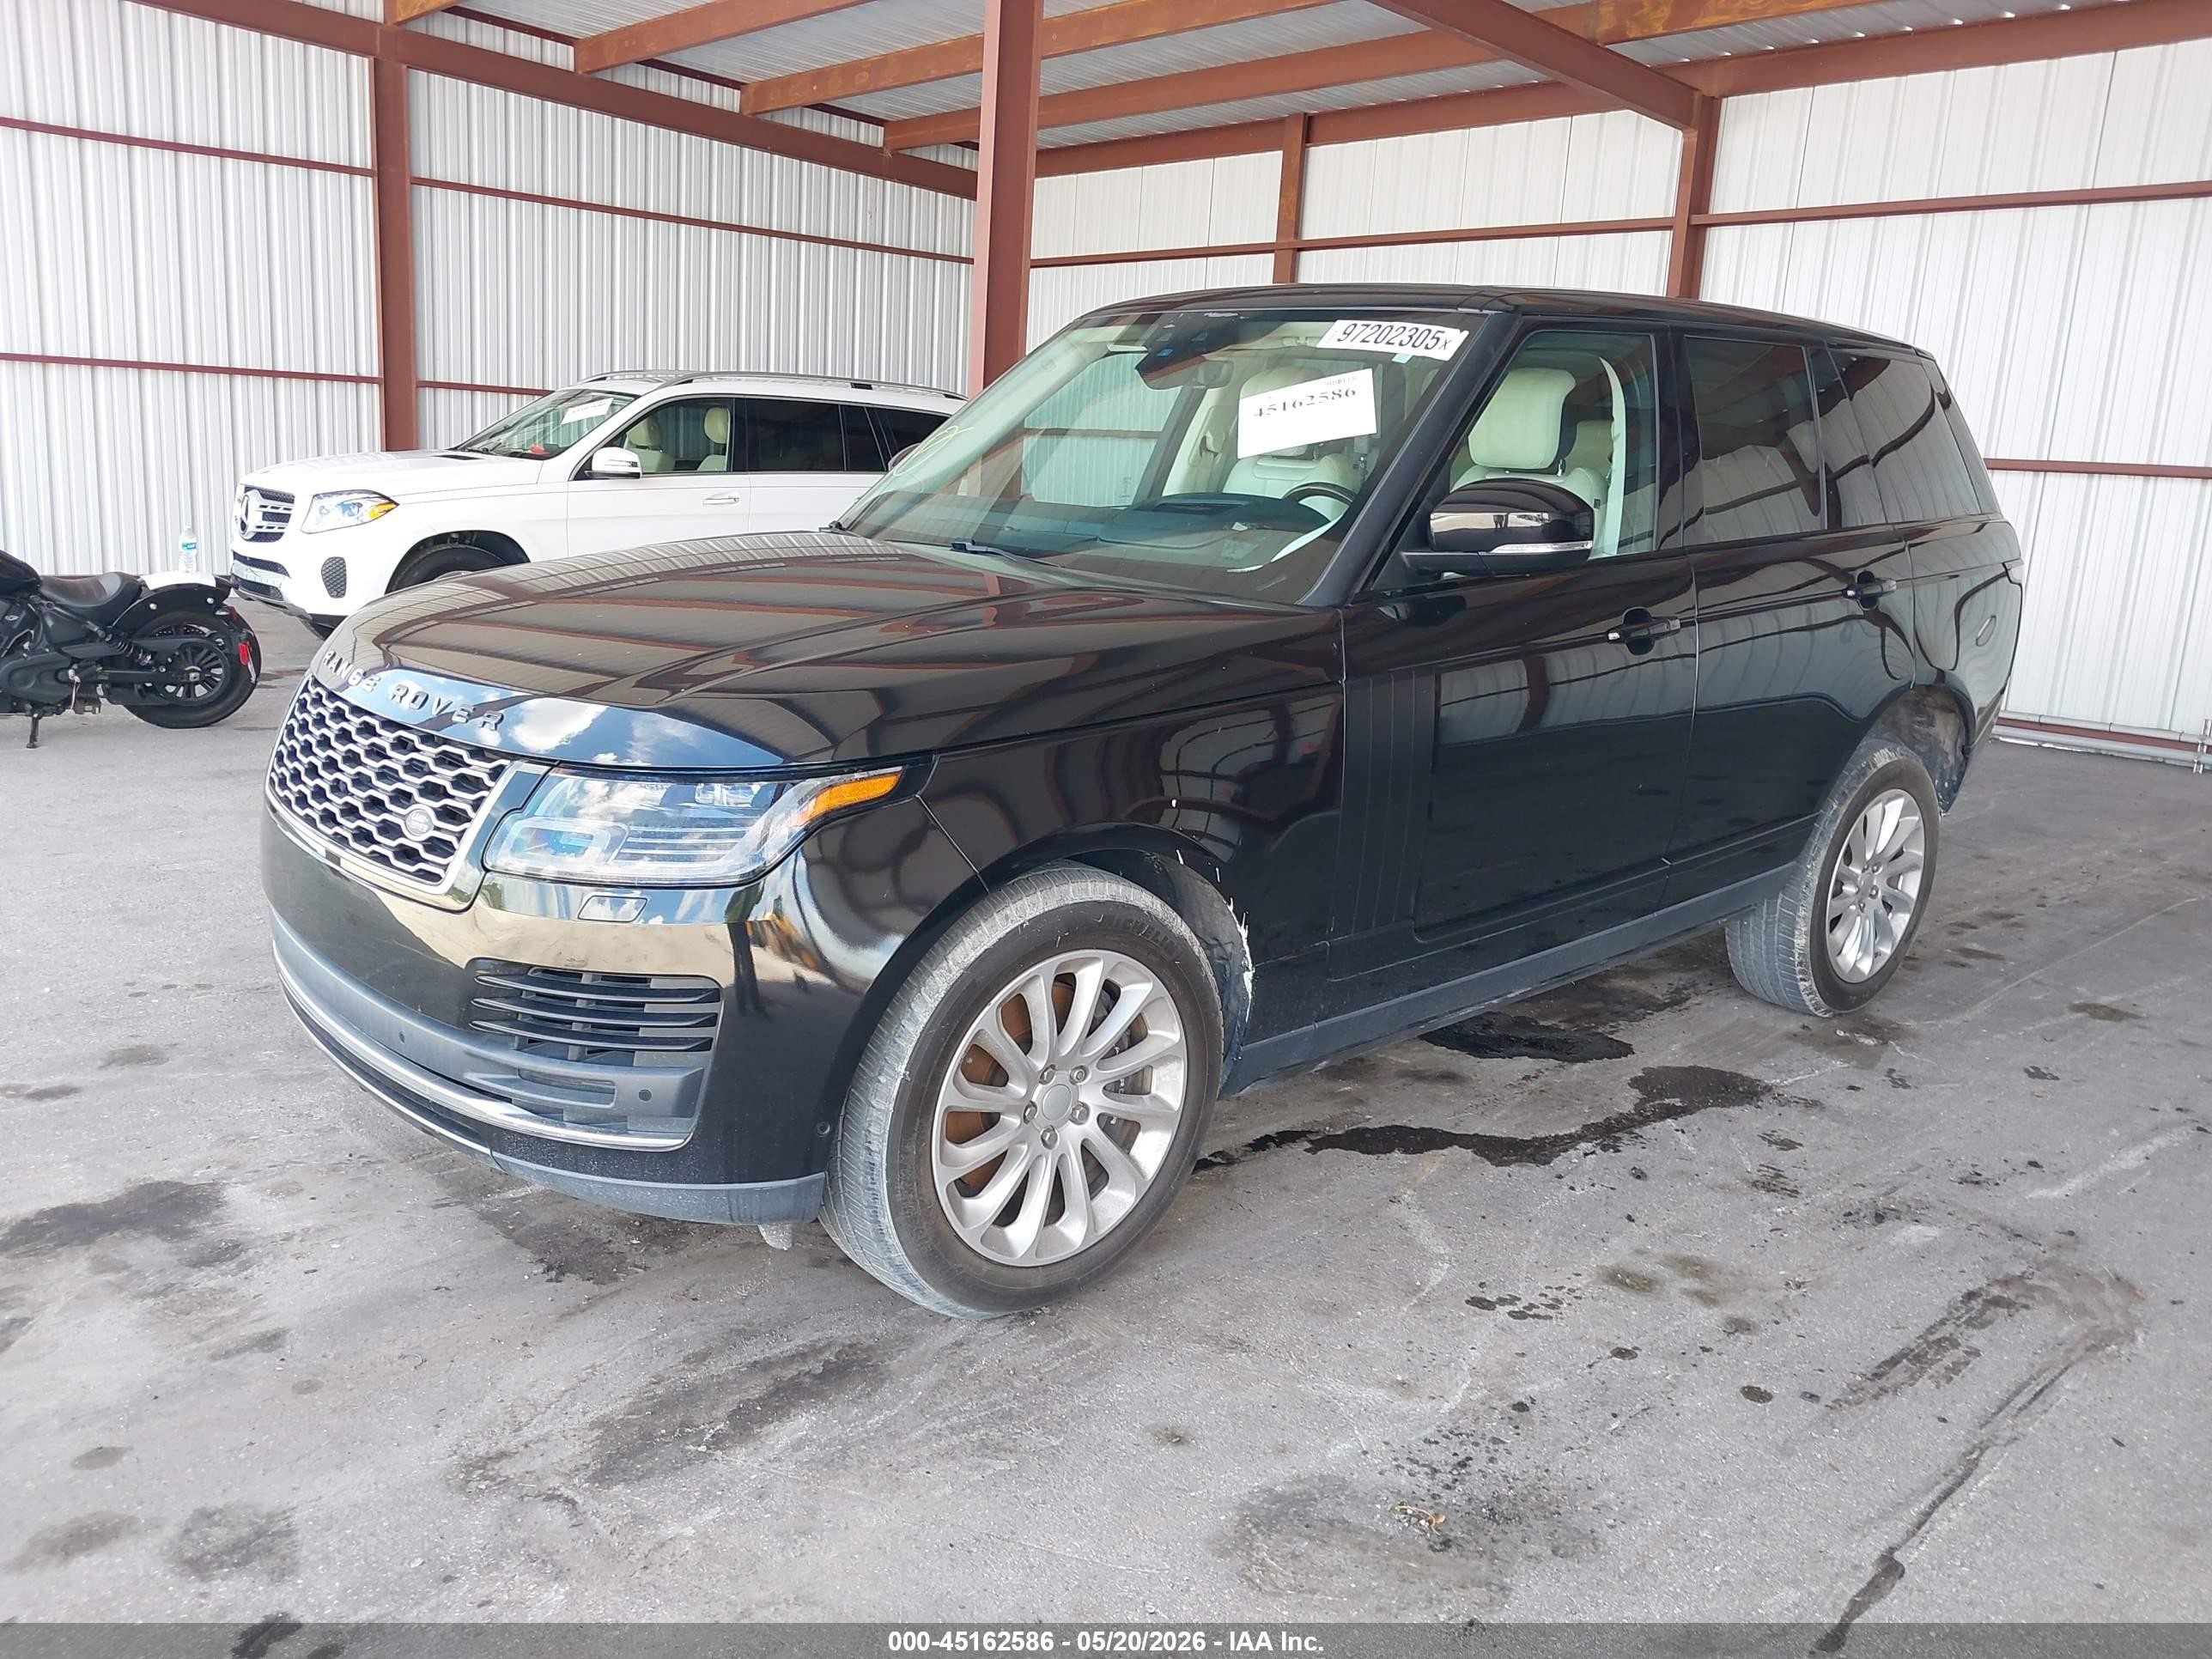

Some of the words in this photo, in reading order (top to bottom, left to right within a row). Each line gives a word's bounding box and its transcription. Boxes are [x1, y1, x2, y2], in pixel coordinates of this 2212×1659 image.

[1253, 388, 1356, 417] 45162586
[321, 650, 381, 694] RANGE
[387, 684, 505, 732] ROVER
